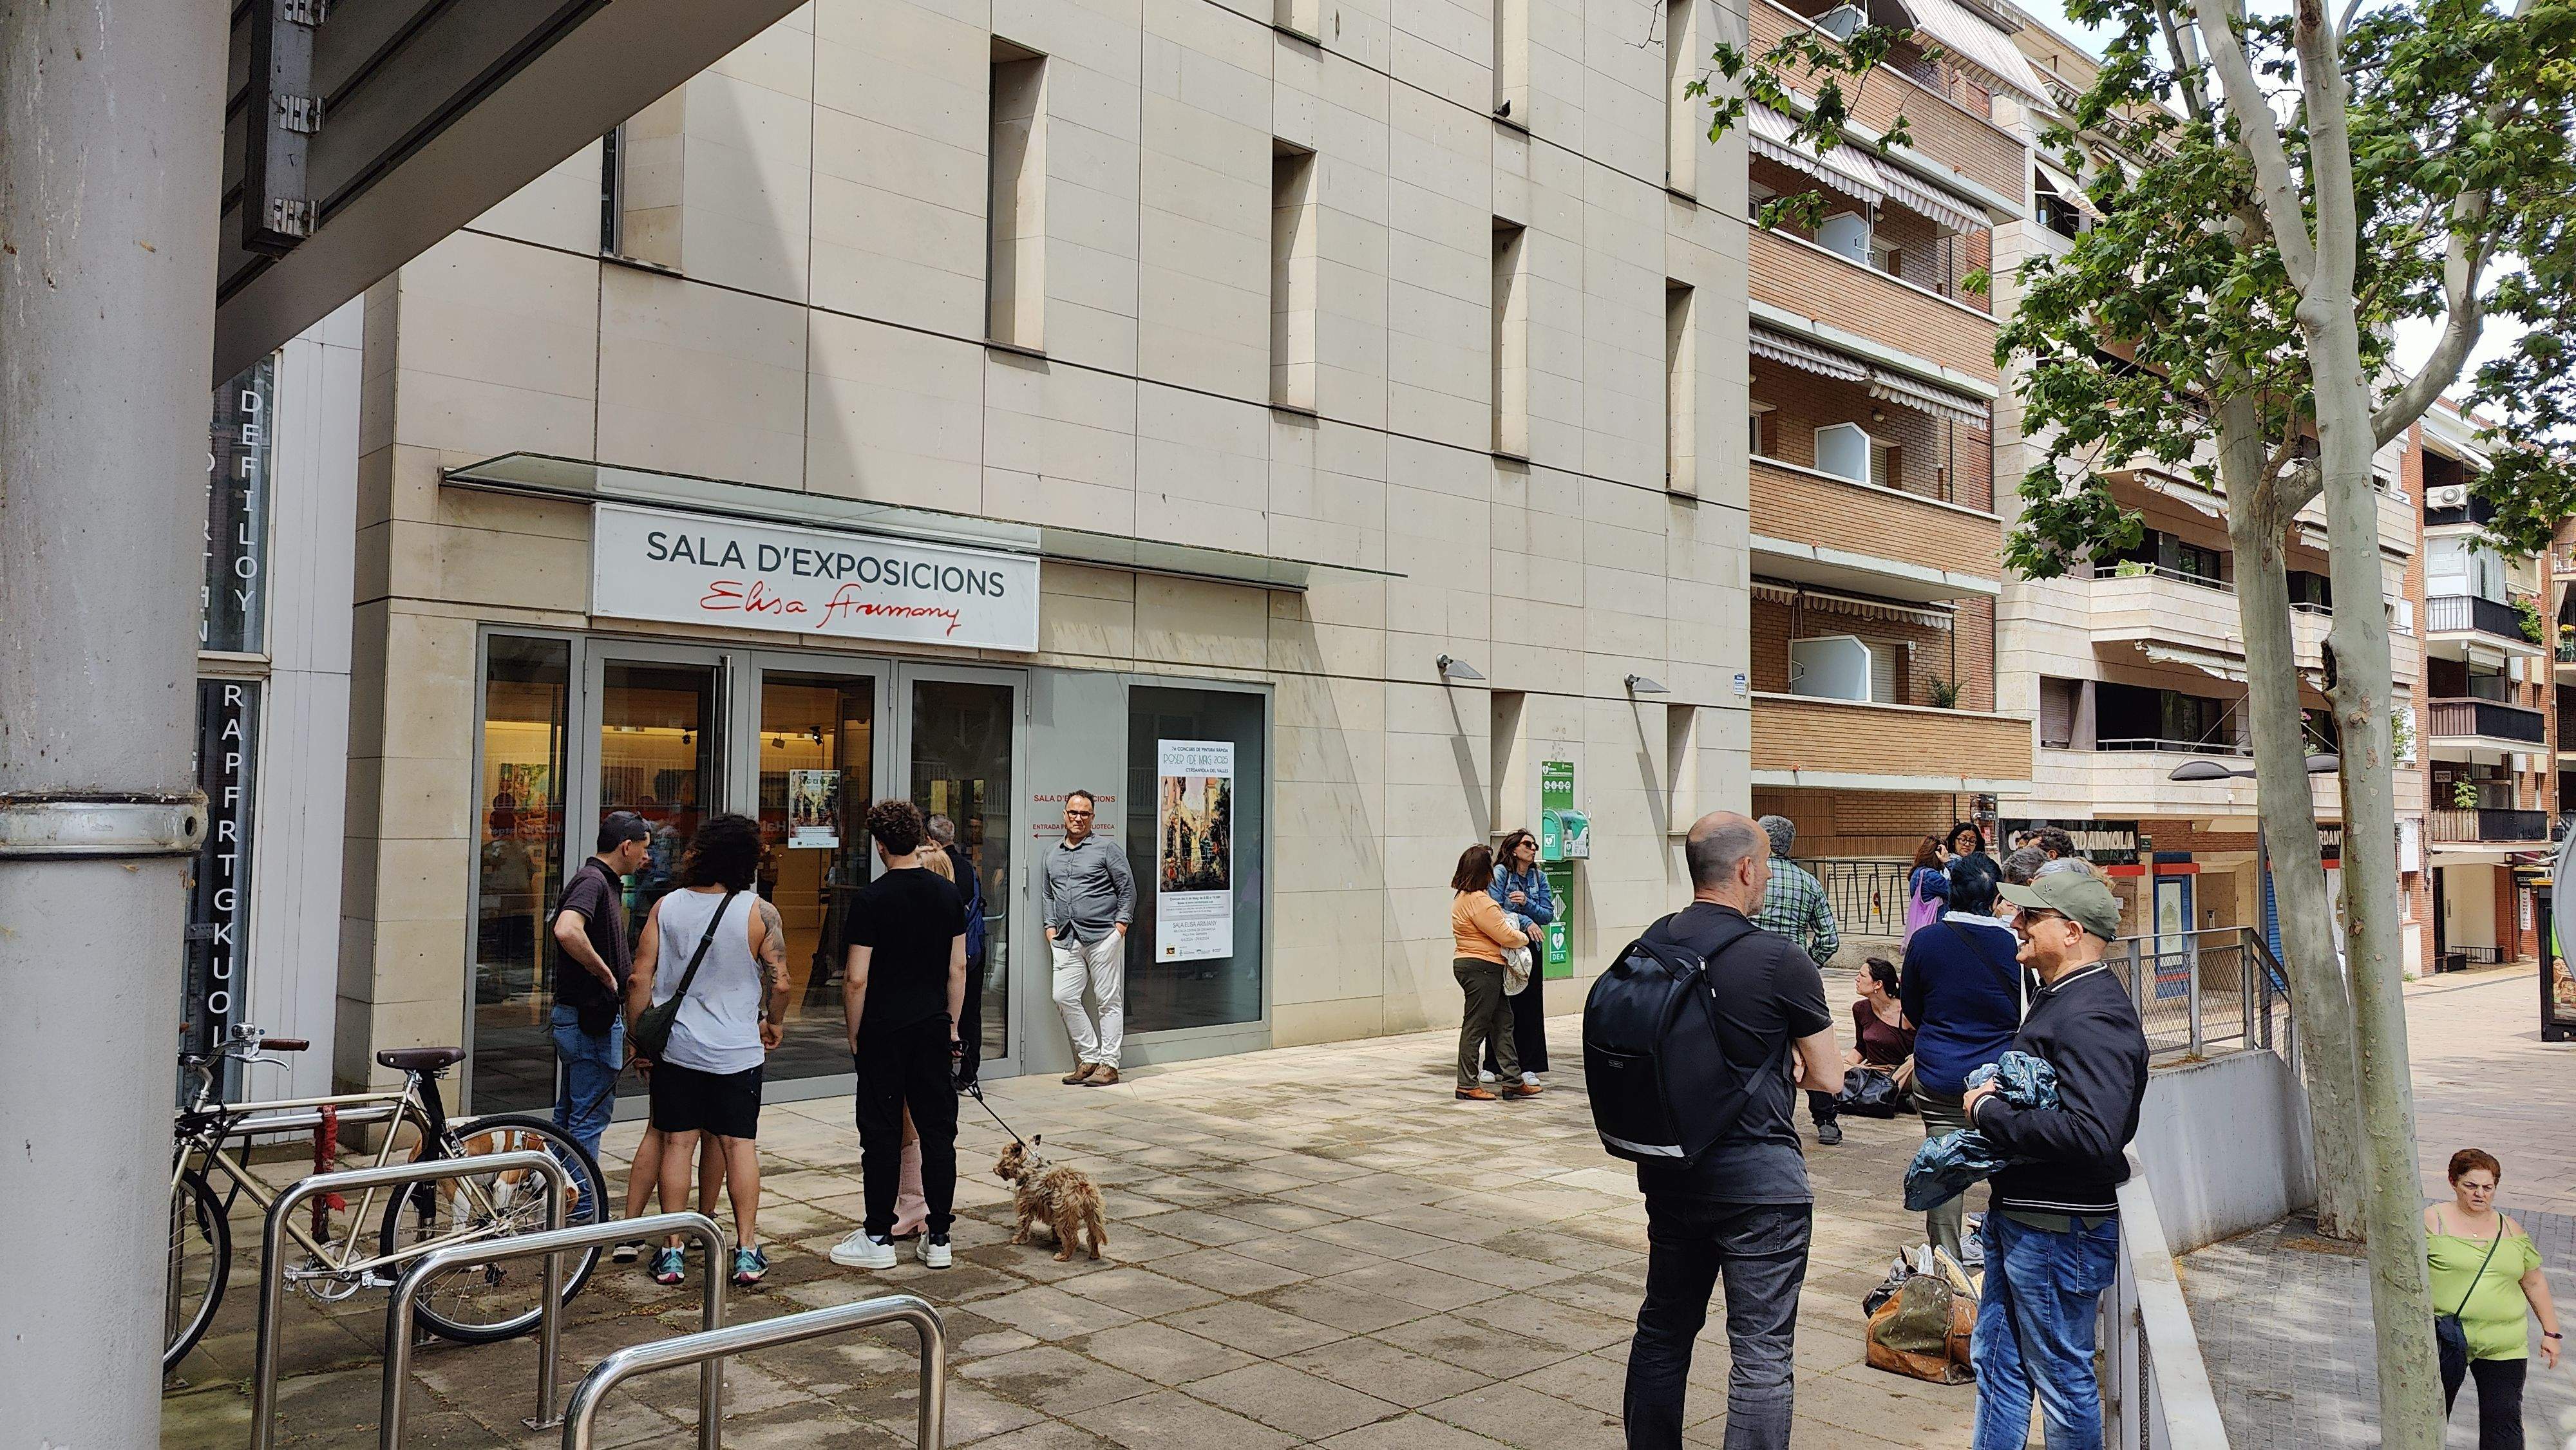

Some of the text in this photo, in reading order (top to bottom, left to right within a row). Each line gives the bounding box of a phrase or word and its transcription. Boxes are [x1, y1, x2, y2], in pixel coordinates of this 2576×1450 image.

[647, 531, 1005, 598] SALA D'EXPOSICIONS
[700, 580, 962, 637] Elisa Arimany
